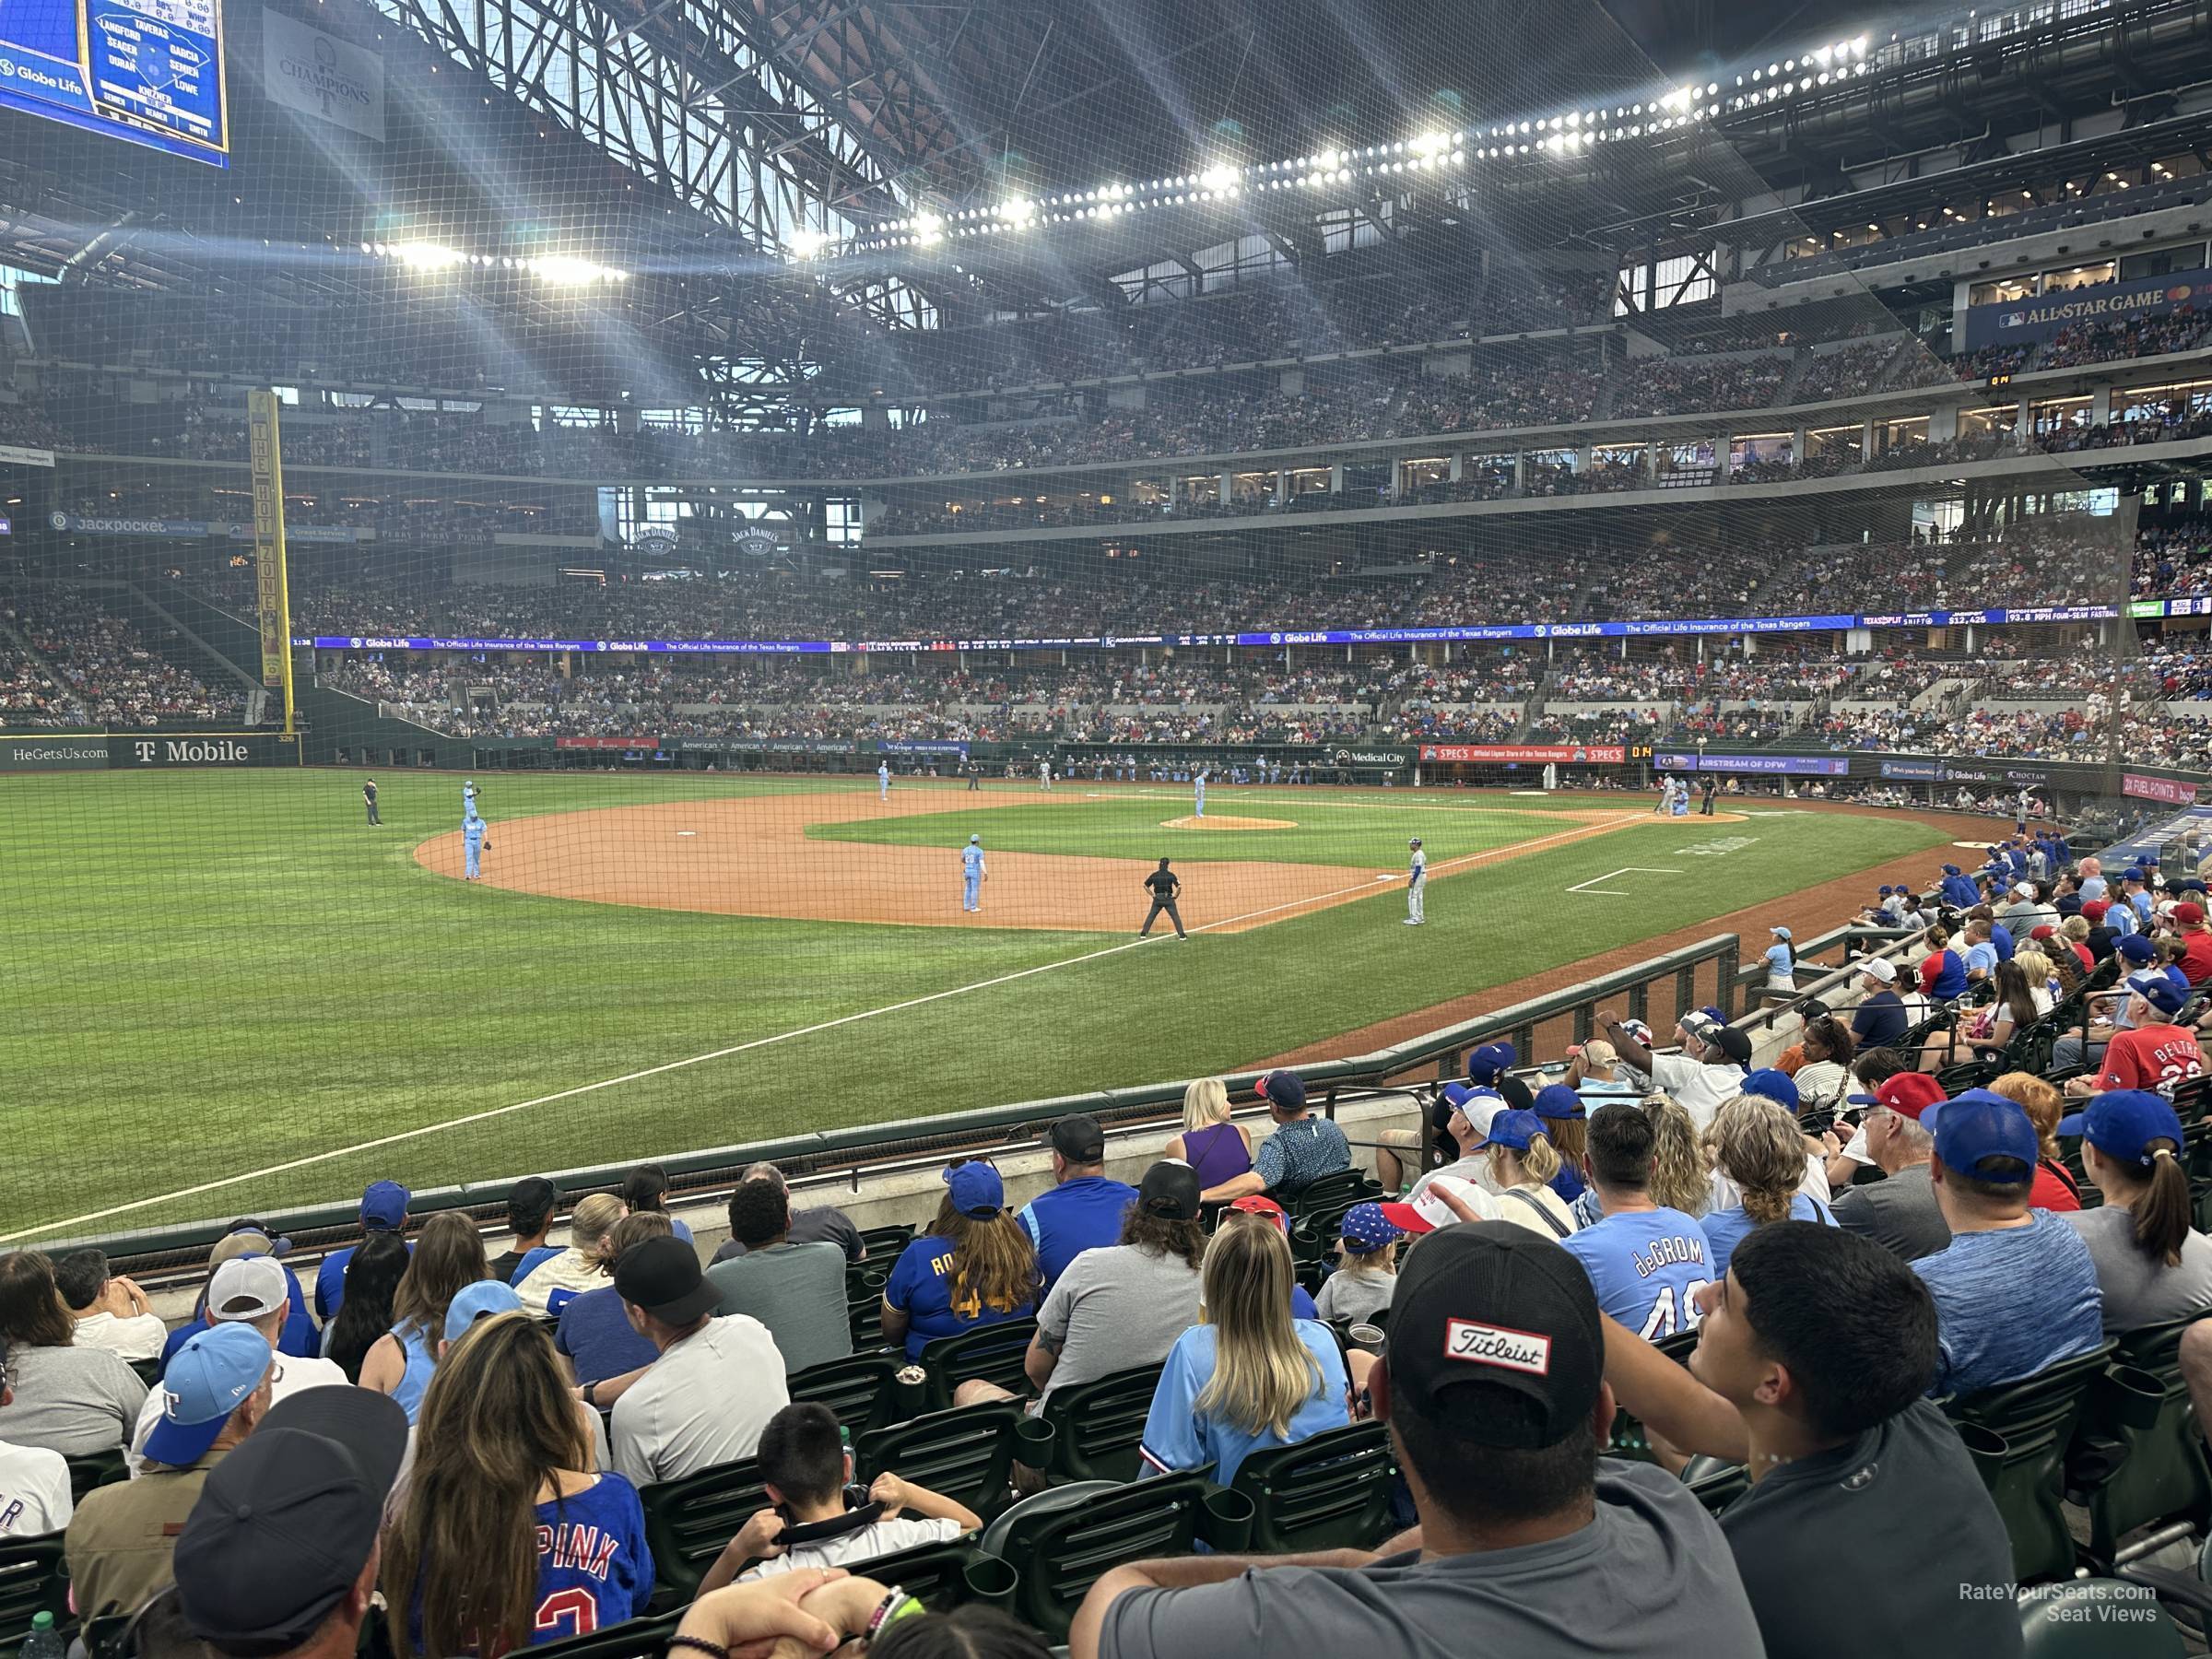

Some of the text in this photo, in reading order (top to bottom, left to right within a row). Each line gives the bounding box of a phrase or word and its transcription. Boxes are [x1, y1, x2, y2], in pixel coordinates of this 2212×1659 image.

[187, 11, 207, 24] WHIP
[100, 18, 141, 42] LANGFORD
[134, 18, 170, 40] TAVERAS
[107, 36, 138, 55] SEAGER
[169, 59, 200, 78] SEMIEN
[17, 65, 83, 96] Globe Life
[279, 58, 371, 105] CHAMPIONS
[173, 77, 199, 97] LOWE
[138, 84, 172, 106] KNIZNER
[2109, 288, 2164, 311] GAME
[731, 529, 749, 543] JACK
[2009, 612, 2052, 622] 93.8 MPH
[2053, 609, 2120, 620] FOUR-SEAM FASTBALL
[1643, 624, 1671, 632] Official
[1674, 623, 1688, 631] Life
[1689, 622, 1728, 630] Insurance
[1741, 621, 1754, 629] the
[1756, 620, 1777, 629] Texas
[1779, 619, 1810, 629] Rangers
[1864, 617, 1882, 625] TEXAS
[1350, 632, 1362, 641] The
[1390, 631, 1403, 640] Life
[1461, 629, 1481, 638] Texas
[1483, 629, 1512, 638] Rangers
[1551, 625, 1601, 636] Globe Life
[1285, 632, 1327, 642] Globe Life
[366, 639, 410, 648] Globe Life
[555, 642, 580, 651] Rangers
[610, 642, 648, 651] Globe Life
[677, 642, 699, 651] Official
[776, 643, 800, 652] Rangers
[135, 740, 249, 762] T Mobile
[683, 741, 718, 749] American
[731, 742, 760, 750] American
[773, 743, 803, 751] American
[817, 743, 847, 752] American
[13, 747, 109, 761] HeGetsUs.com
[1352, 752, 1405, 764] Medical City
[1441, 747, 1469, 759] SPEC'S
[1474, 749, 1490, 758] Official
[1491, 750, 1505, 759] Liquor
[1548, 750, 1567, 759] Rangers
[1591, 747, 1622, 759] SPEC'S
[1699, 759, 1748, 768] AIRSTREAM
[1764, 760, 1786, 769] DFW
[1955, 771, 1973, 780] Globe
[1974, 771, 1986, 781] Life
[2010, 771, 2046, 781] CHOCTAW
[2124, 778, 2175, 799] 2X FUEL POINTS
[1631, 1235, 1705, 1278] deGROM
[1452, 1329, 1544, 1365] Titleist
[162, 1388, 181, 1418] T
